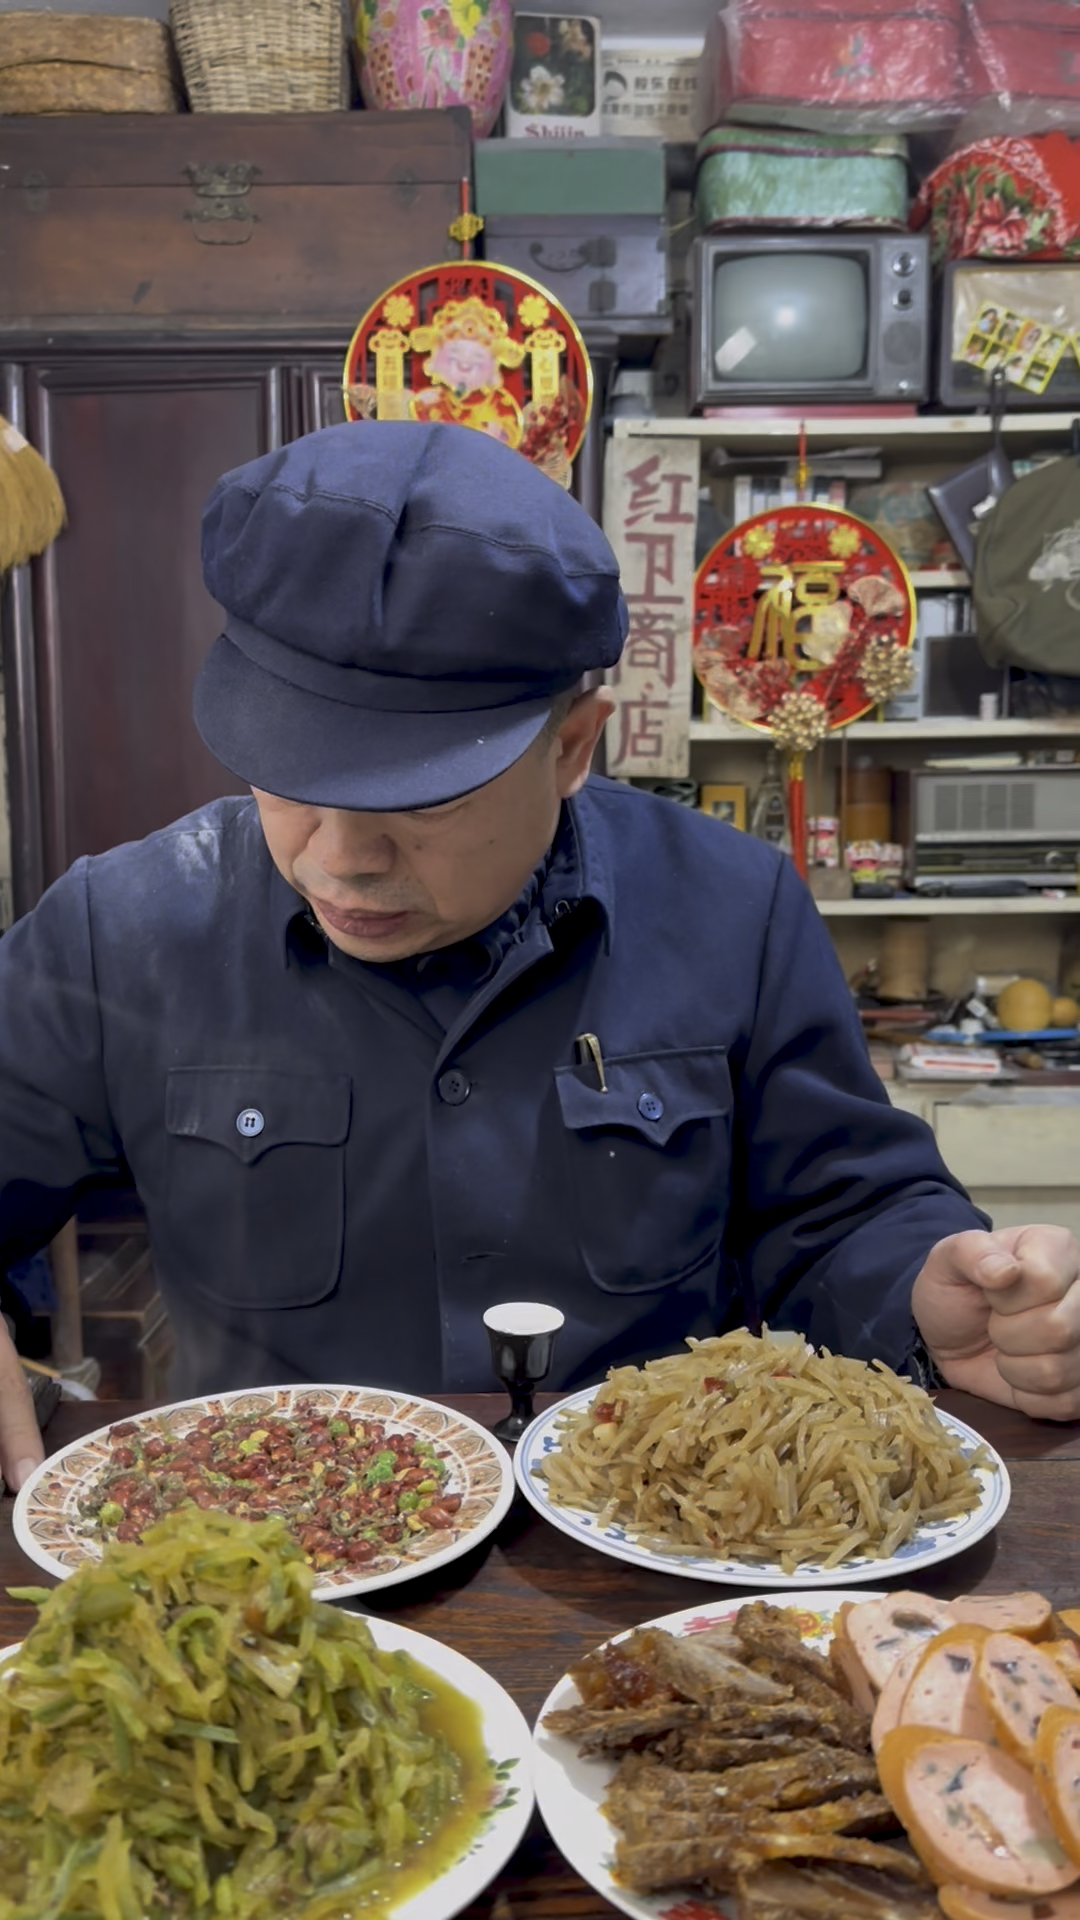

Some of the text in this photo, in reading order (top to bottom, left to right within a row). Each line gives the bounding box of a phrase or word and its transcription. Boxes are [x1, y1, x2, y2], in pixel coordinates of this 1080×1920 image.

[612, 454, 695, 768] 红卫商店
[747, 559, 847, 672] 福
